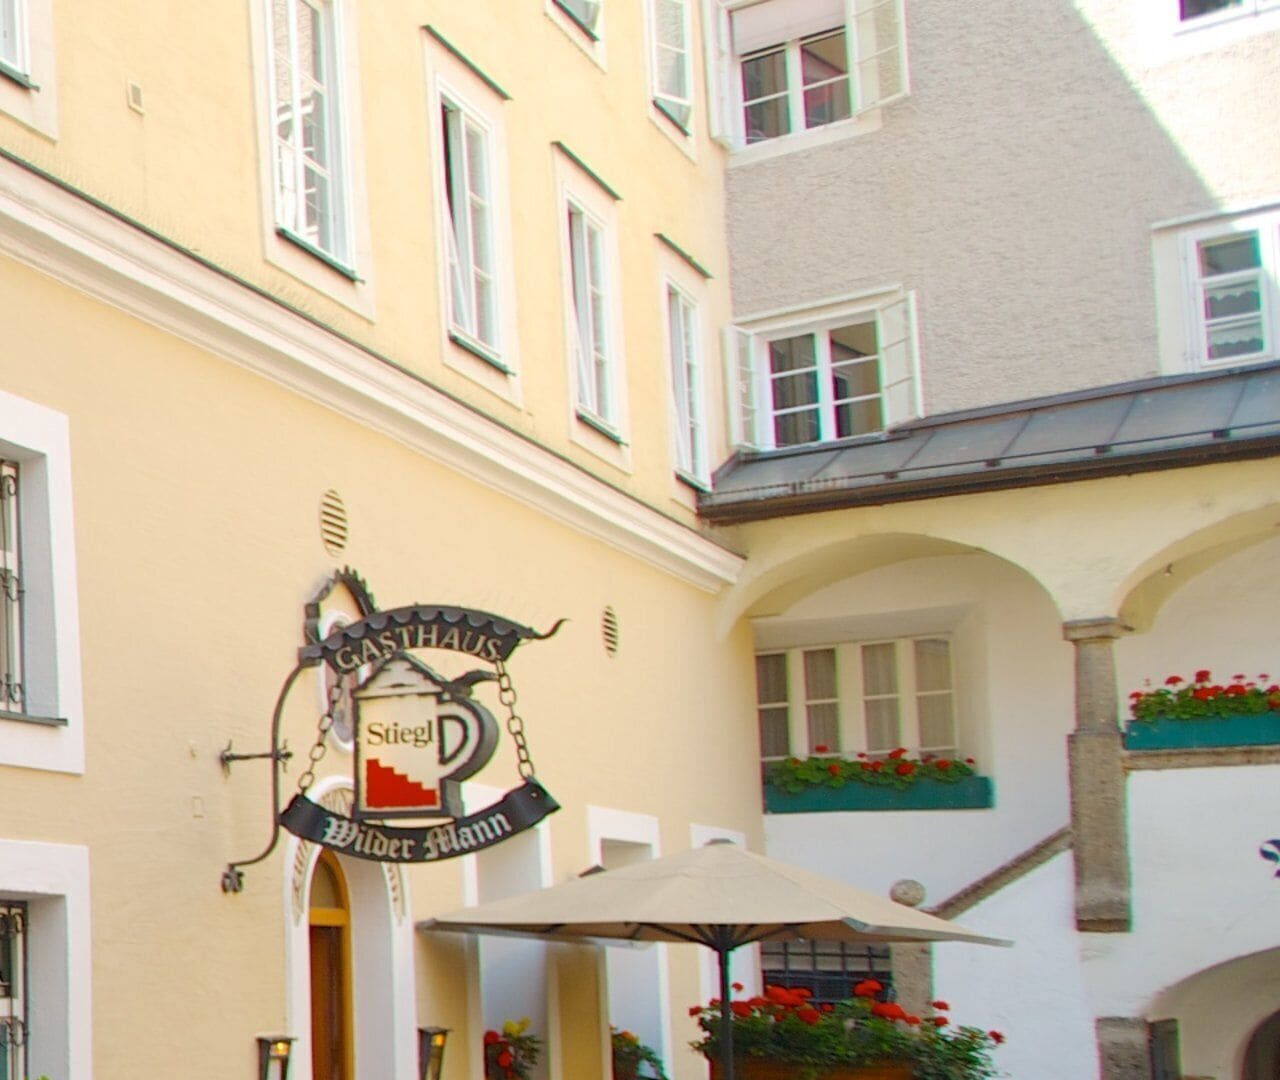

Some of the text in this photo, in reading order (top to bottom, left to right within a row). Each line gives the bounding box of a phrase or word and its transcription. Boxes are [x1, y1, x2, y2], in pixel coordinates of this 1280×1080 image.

[335, 625, 502, 671] GASTHAUS
[366, 720, 434, 749] Stiegl
[323, 811, 513, 860] Wilder Mann
